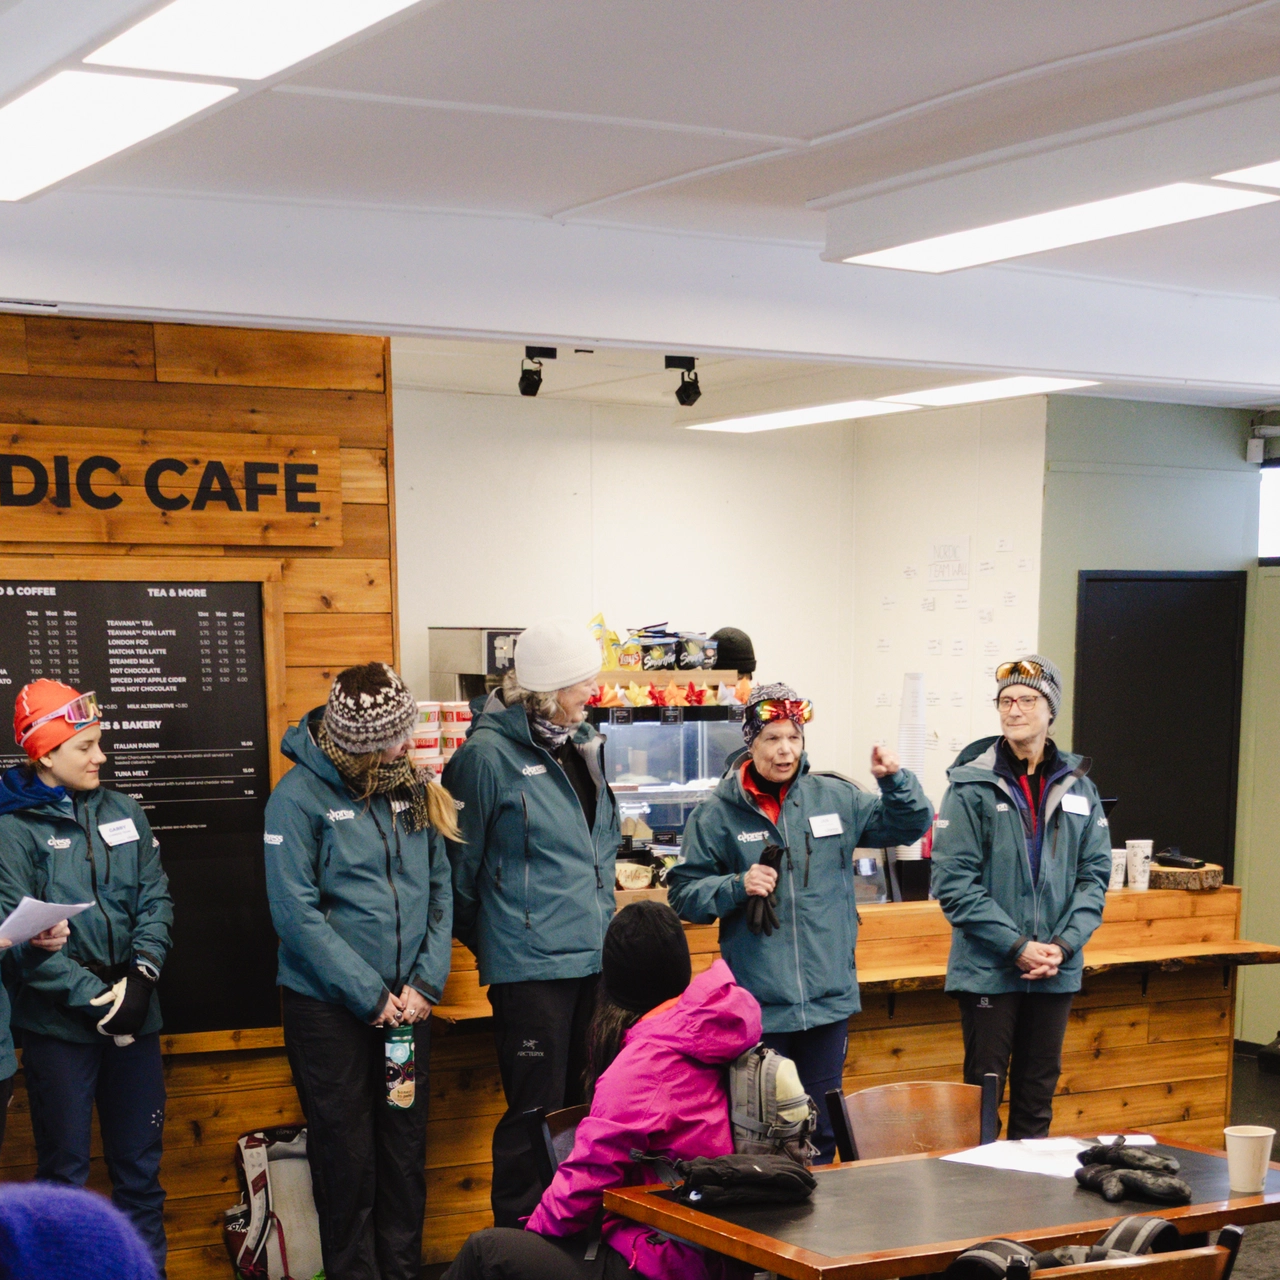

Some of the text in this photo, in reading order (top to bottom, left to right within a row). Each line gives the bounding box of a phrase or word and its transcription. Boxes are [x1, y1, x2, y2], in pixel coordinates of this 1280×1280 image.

[144, 458, 321, 513] CAFE
[6, 587, 14, 596] &
[16, 586, 56, 596] COFFEE
[147, 588, 207, 598] TEA & MORE
[100, 720, 162, 730] ES & BAKERY
